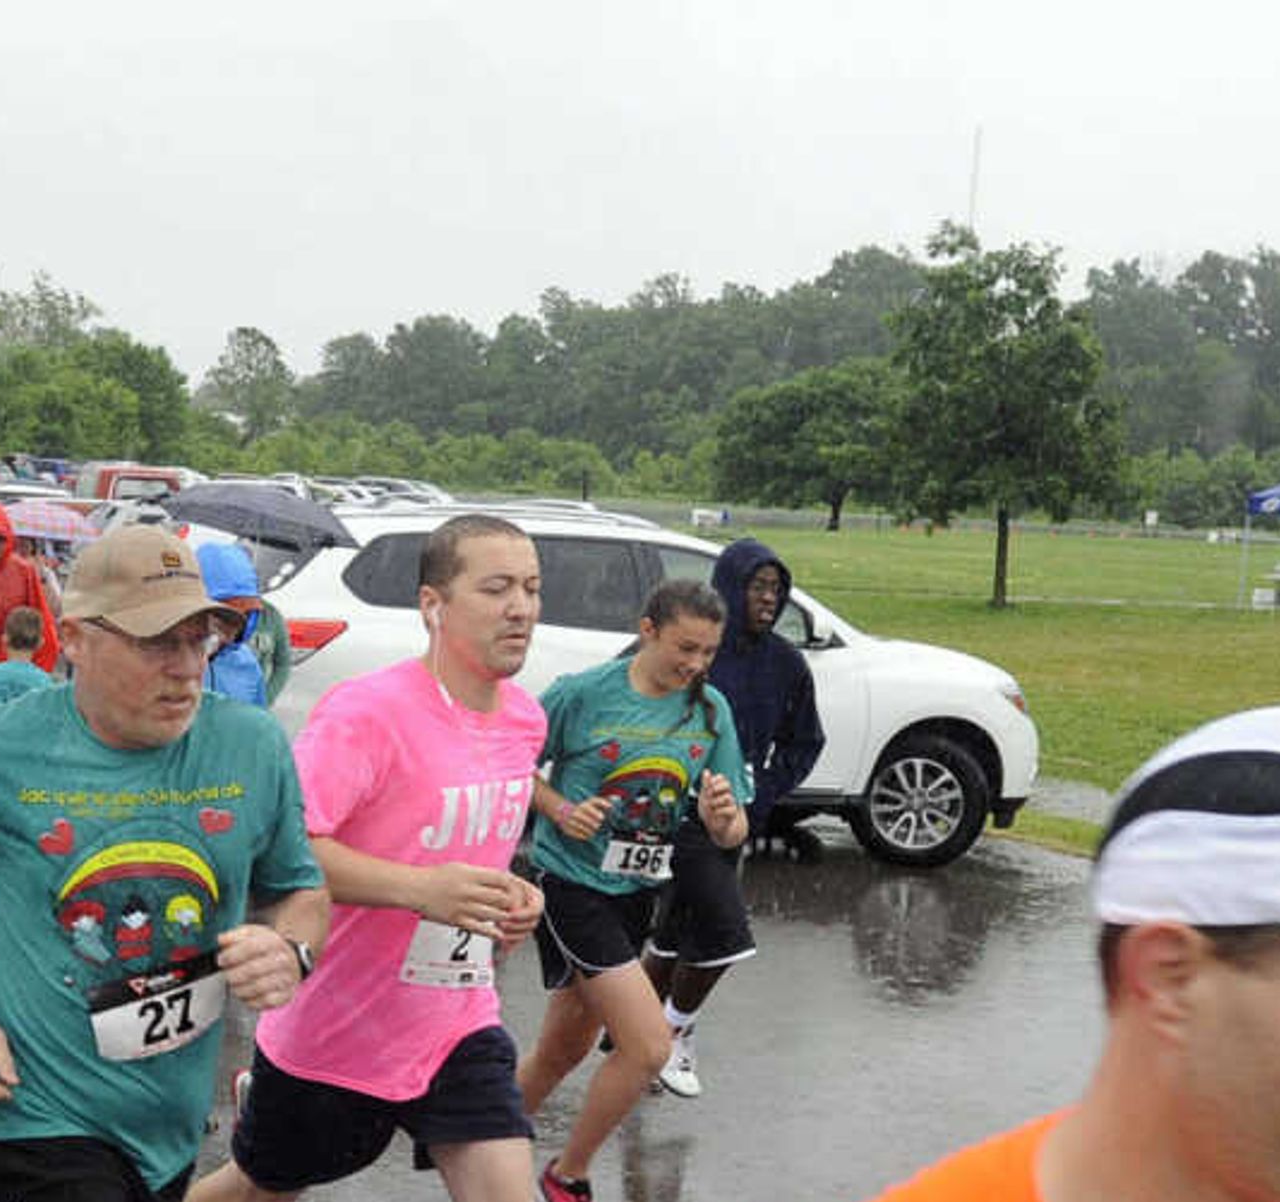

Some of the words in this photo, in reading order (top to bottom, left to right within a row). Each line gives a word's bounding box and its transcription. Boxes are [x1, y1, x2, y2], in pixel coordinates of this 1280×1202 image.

[420, 777, 534, 852] JW5
[620, 847, 665, 873] 196
[450, 928, 471, 962] 2
[138, 989, 195, 1045] 27
